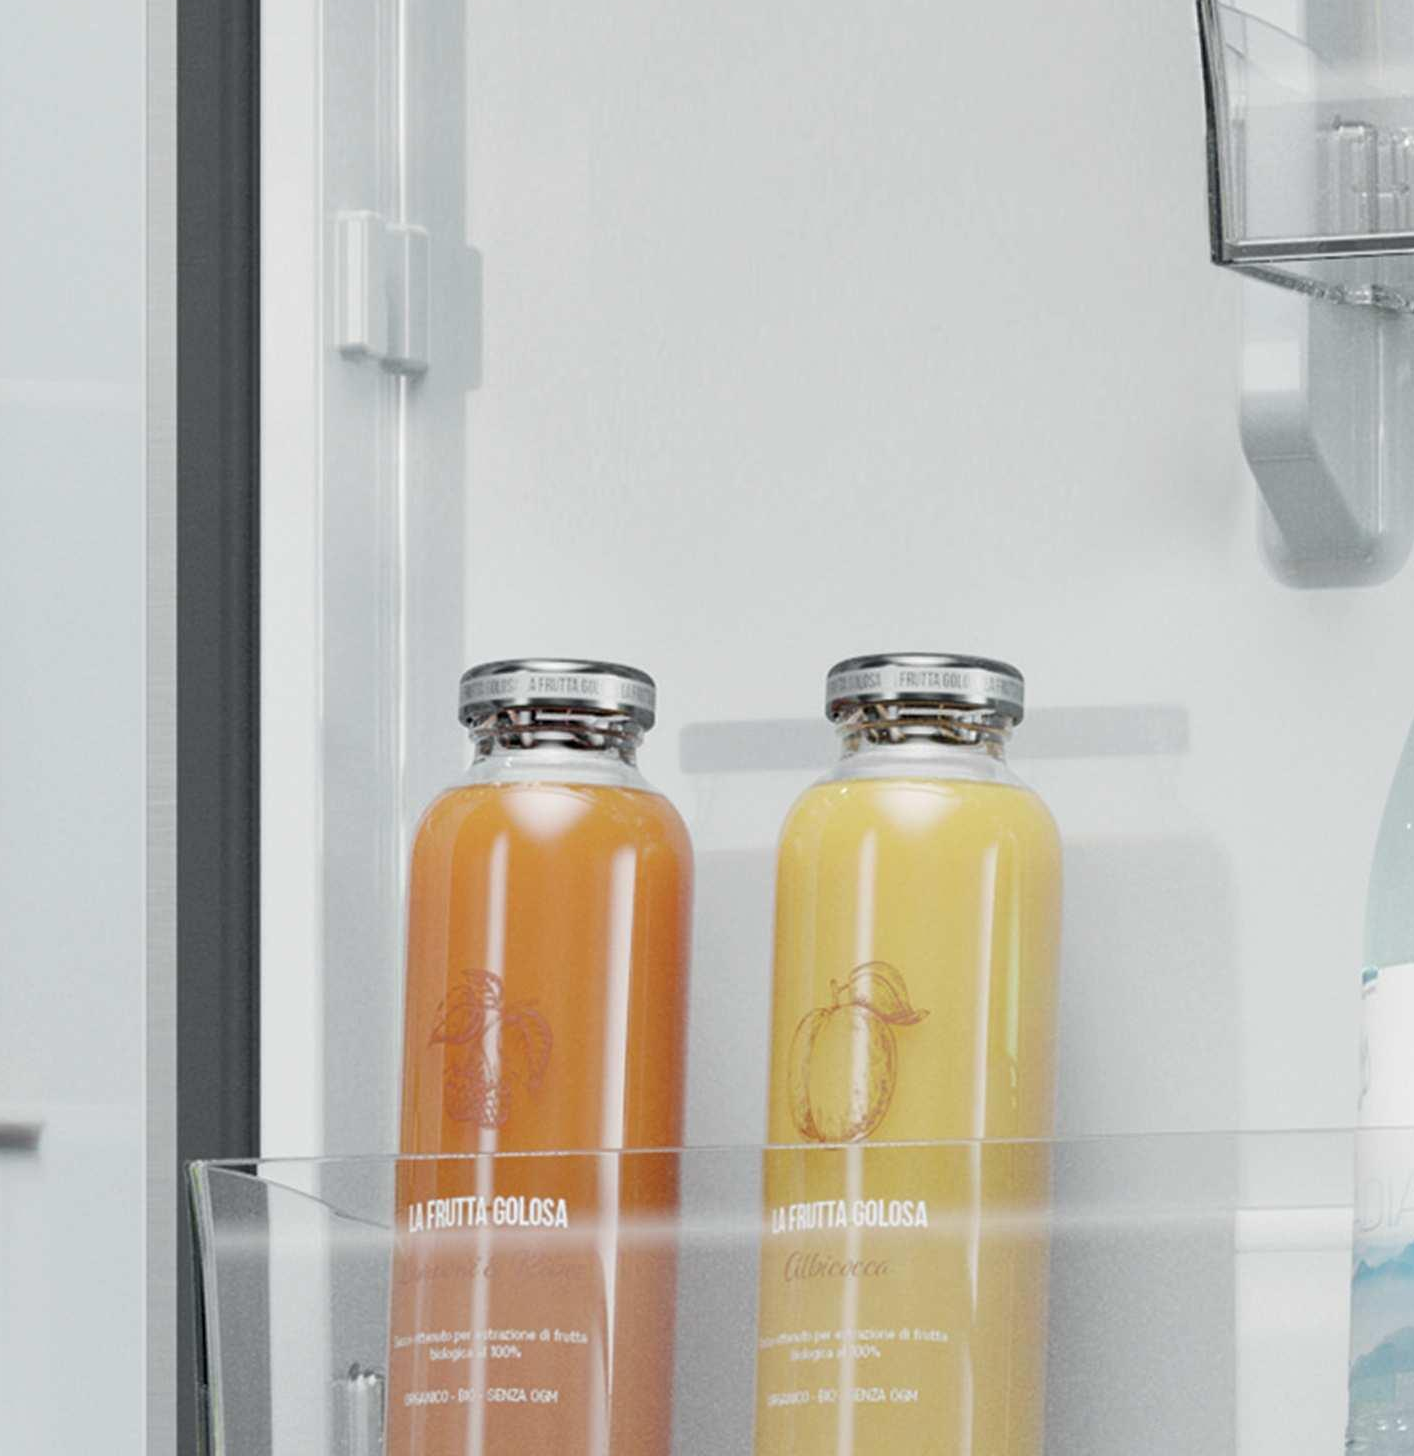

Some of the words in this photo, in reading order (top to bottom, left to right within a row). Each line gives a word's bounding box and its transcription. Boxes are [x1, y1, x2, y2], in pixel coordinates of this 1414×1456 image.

[409, 1201, 424, 1234] LA
[426, 1196, 488, 1230] FRUTTA
[493, 1195, 569, 1230] GOLOSA
[772, 1205, 786, 1235] LA
[788, 1199, 848, 1231] FRUTTA
[852, 1198, 929, 1230] GOLOSA
